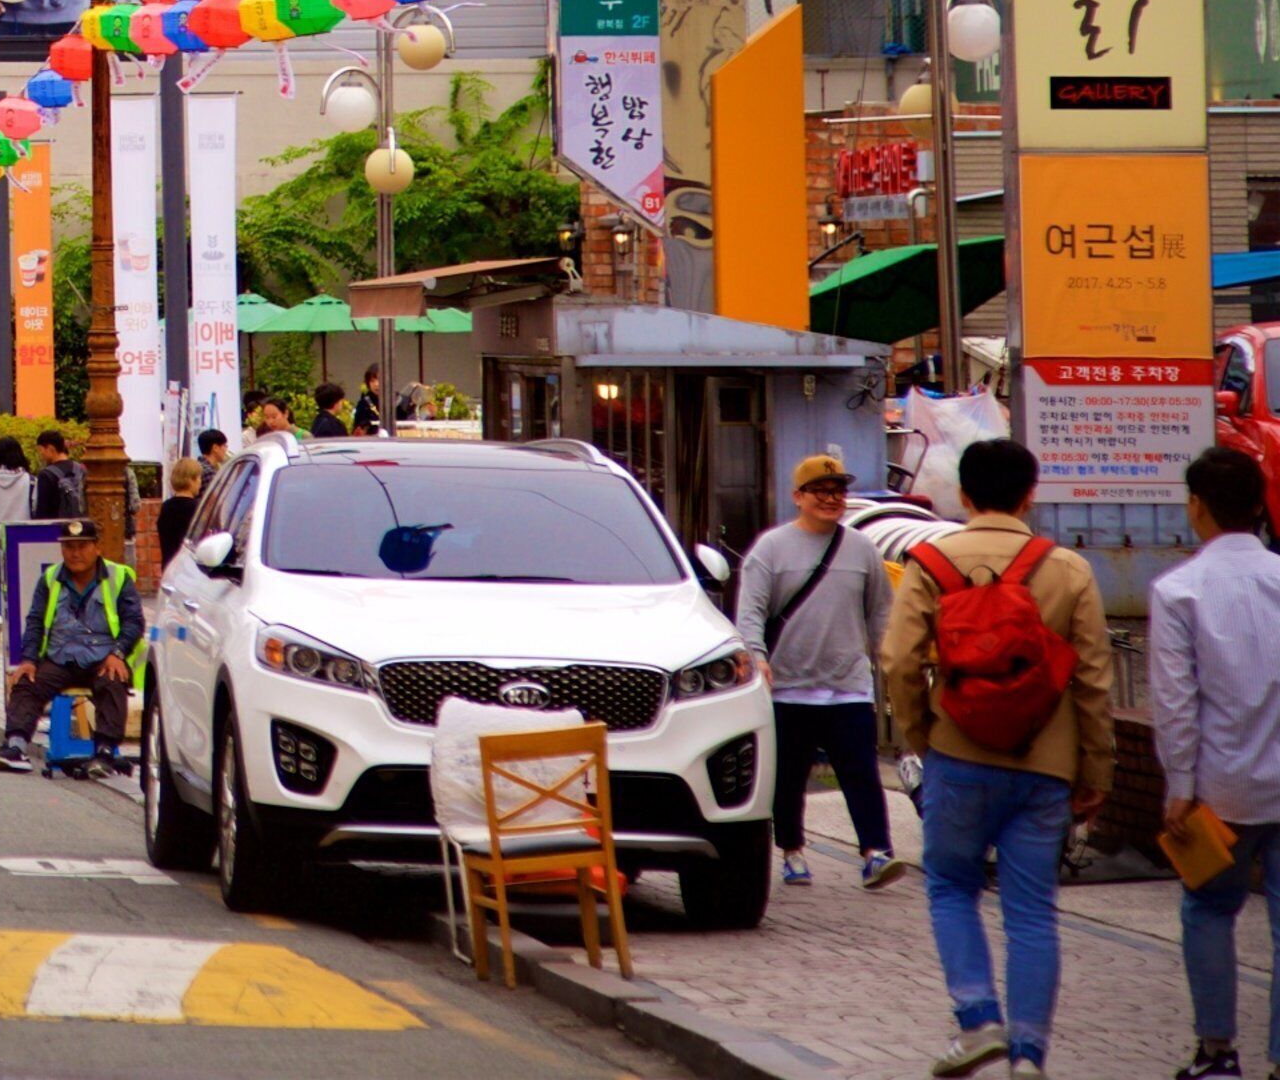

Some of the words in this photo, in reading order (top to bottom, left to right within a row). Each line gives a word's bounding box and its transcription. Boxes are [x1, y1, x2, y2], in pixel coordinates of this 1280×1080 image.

[632, 14, 650, 29] 2F
[604, 51, 656, 64] 한식뷔페
[585, 72, 615, 170] 행복한
[621, 95, 653, 151] 밥상
[644, 196, 661, 208] B1
[1106, 276, 1133, 290] 4.25
[1148, 276, 1167, 290] 5.8
[16, 345, 52, 365] 할인
[1059, 366, 1123, 381] 고객전용
[1132, 365, 1180, 381] 주차장
